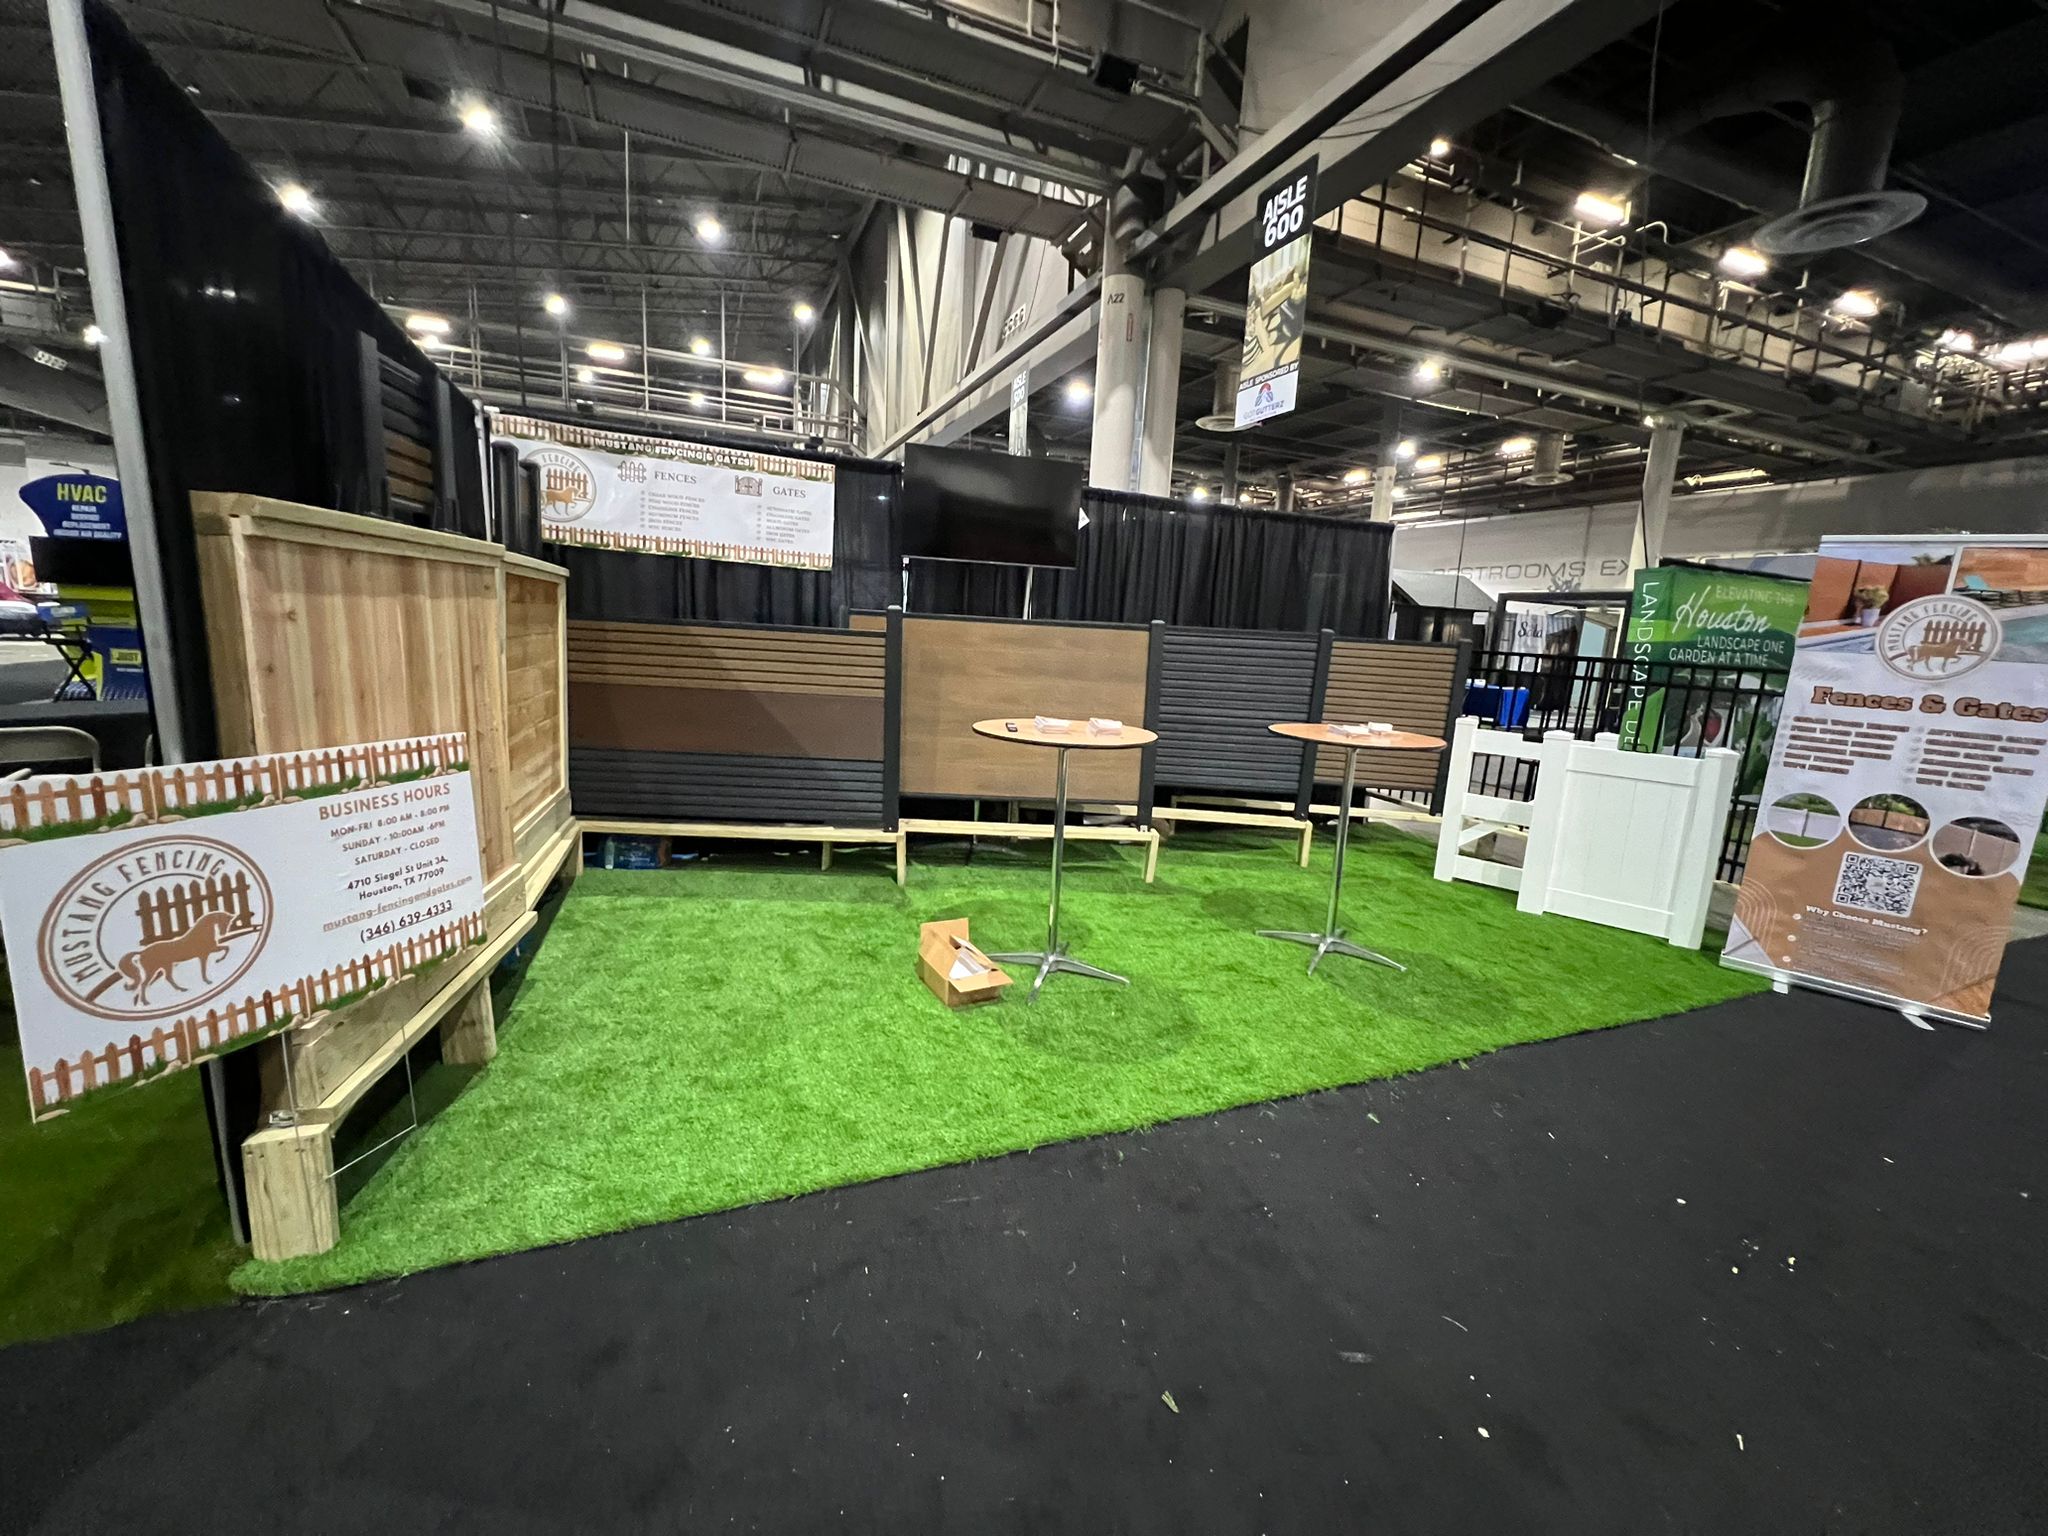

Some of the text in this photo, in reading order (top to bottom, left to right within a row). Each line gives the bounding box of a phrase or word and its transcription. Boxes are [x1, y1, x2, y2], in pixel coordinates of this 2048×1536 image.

[1263, 175, 1308, 226] AISLE
[1264, 204, 1304, 247] 600
[1107, 293, 1125, 304] A22
[595, 438, 651, 453] MUSTANG
[655, 446, 705, 460] FENCING
[716, 454, 750, 467] GATES
[57, 482, 107, 504] HVAC
[654, 471, 698, 484] FENCES
[773, 486, 807, 498] GATES
[1433, 561, 1586, 581] STROOMS
[1671, 585, 1772, 634] Houston
[1715, 584, 1773, 604] ELEVATING
[1887, 603, 1978, 652] MUSTANG FENCING
[1668, 647, 1769, 667] GARDEN AT A TIME
[1697, 635, 1786, 654] LANDSCAPE ONE
[1811, 685, 2048, 723] Fences & Gates
[319, 782, 450, 821] BUSINESS HOURS
[331, 821, 373, 838] MON-FRI
[400, 813, 413, 822] AM
[439, 804, 450, 813] PM
[342, 836, 381, 852] SUNDAY
[354, 847, 402, 866] SATURDAY
[409, 836, 440, 851] CLOSED
[347, 876, 372, 891] 4710
[374, 867, 403, 882] Siegel
[405, 864, 415, 874] St
[416, 859, 434, 871] Unit
[359, 866, 445, 901] Houston, TX 77009
[61, 849, 226, 984] MUSTANG FENCING
[360, 899, 453, 944] (346) 639-4333
[1806, 905, 1829, 917] Why
[1872, 918, 1929, 936] Mustang?
